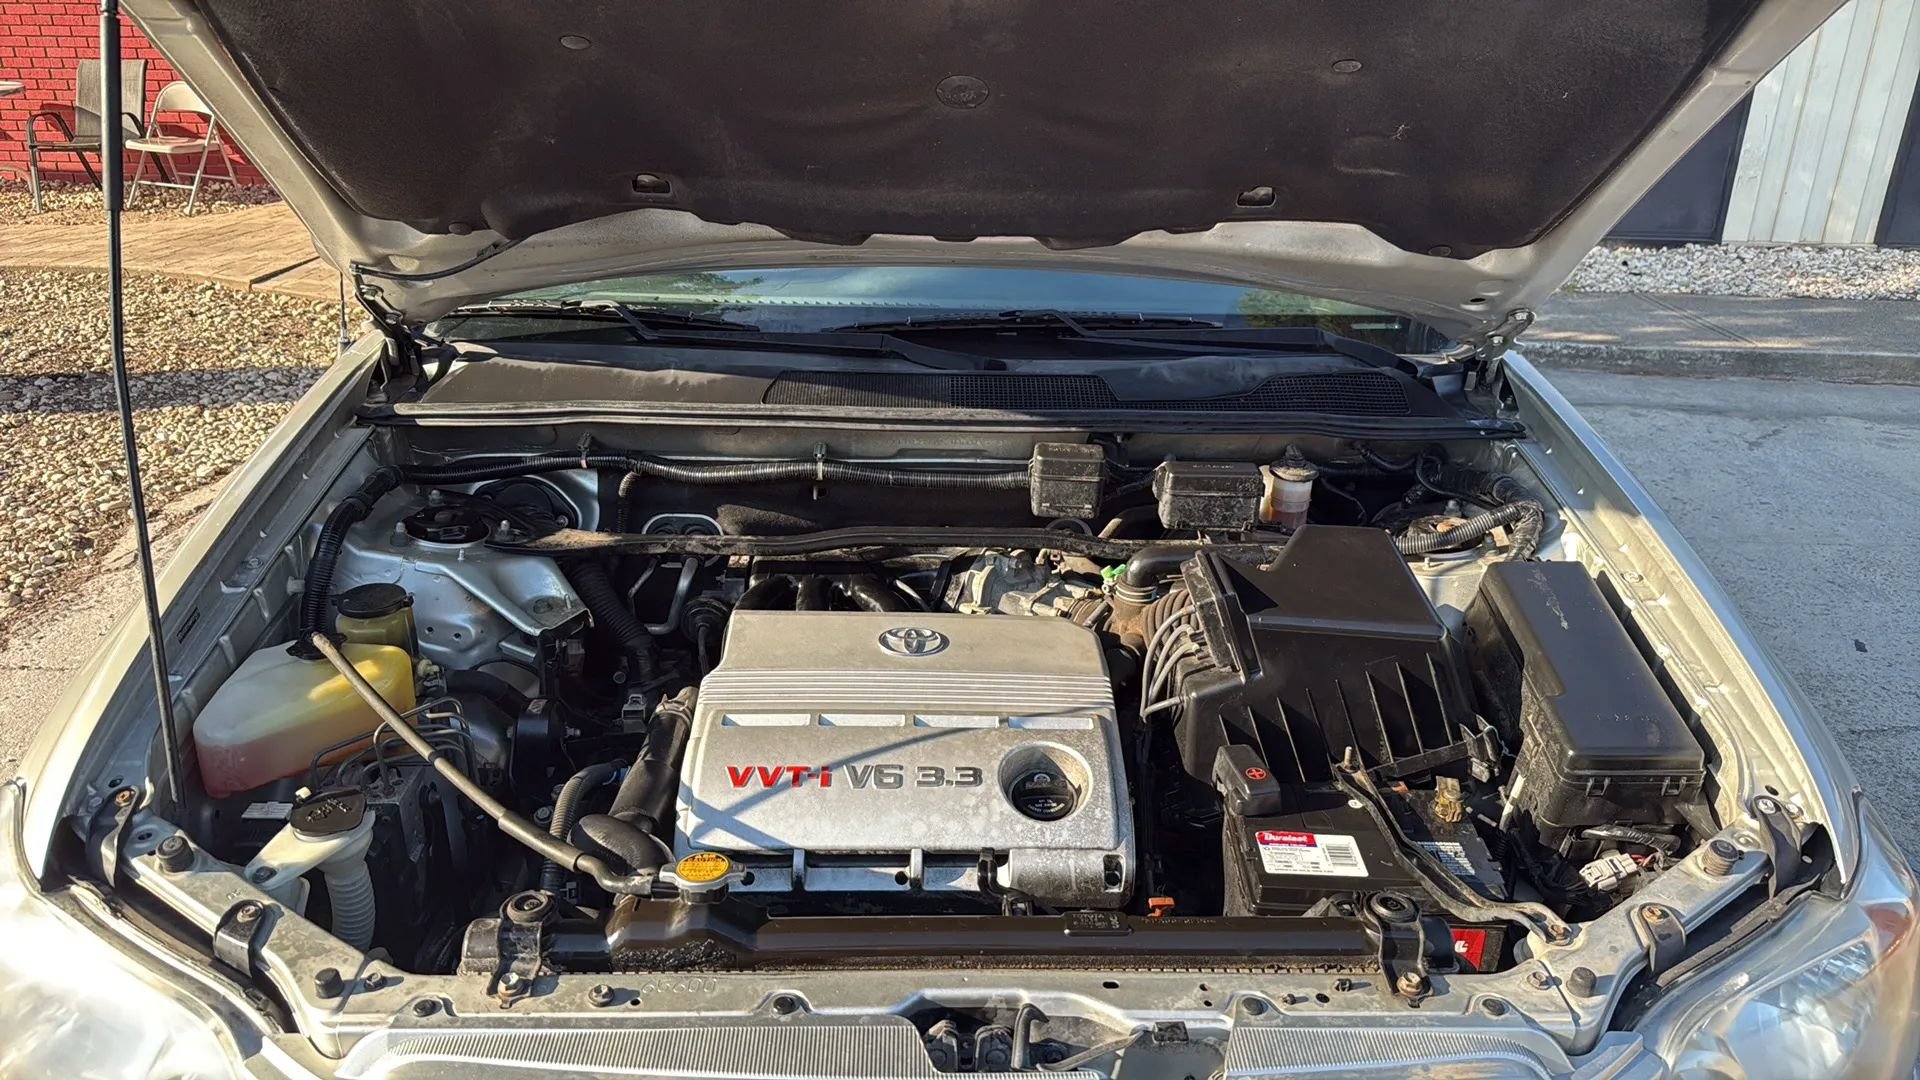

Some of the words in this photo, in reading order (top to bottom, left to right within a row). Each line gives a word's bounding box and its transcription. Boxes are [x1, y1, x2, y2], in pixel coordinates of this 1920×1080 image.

[727, 765, 832, 788] VVT-i
[843, 764, 903, 789] V6
[915, 766, 983, 788] 3.3
[1263, 832, 1308, 842] Duralast
